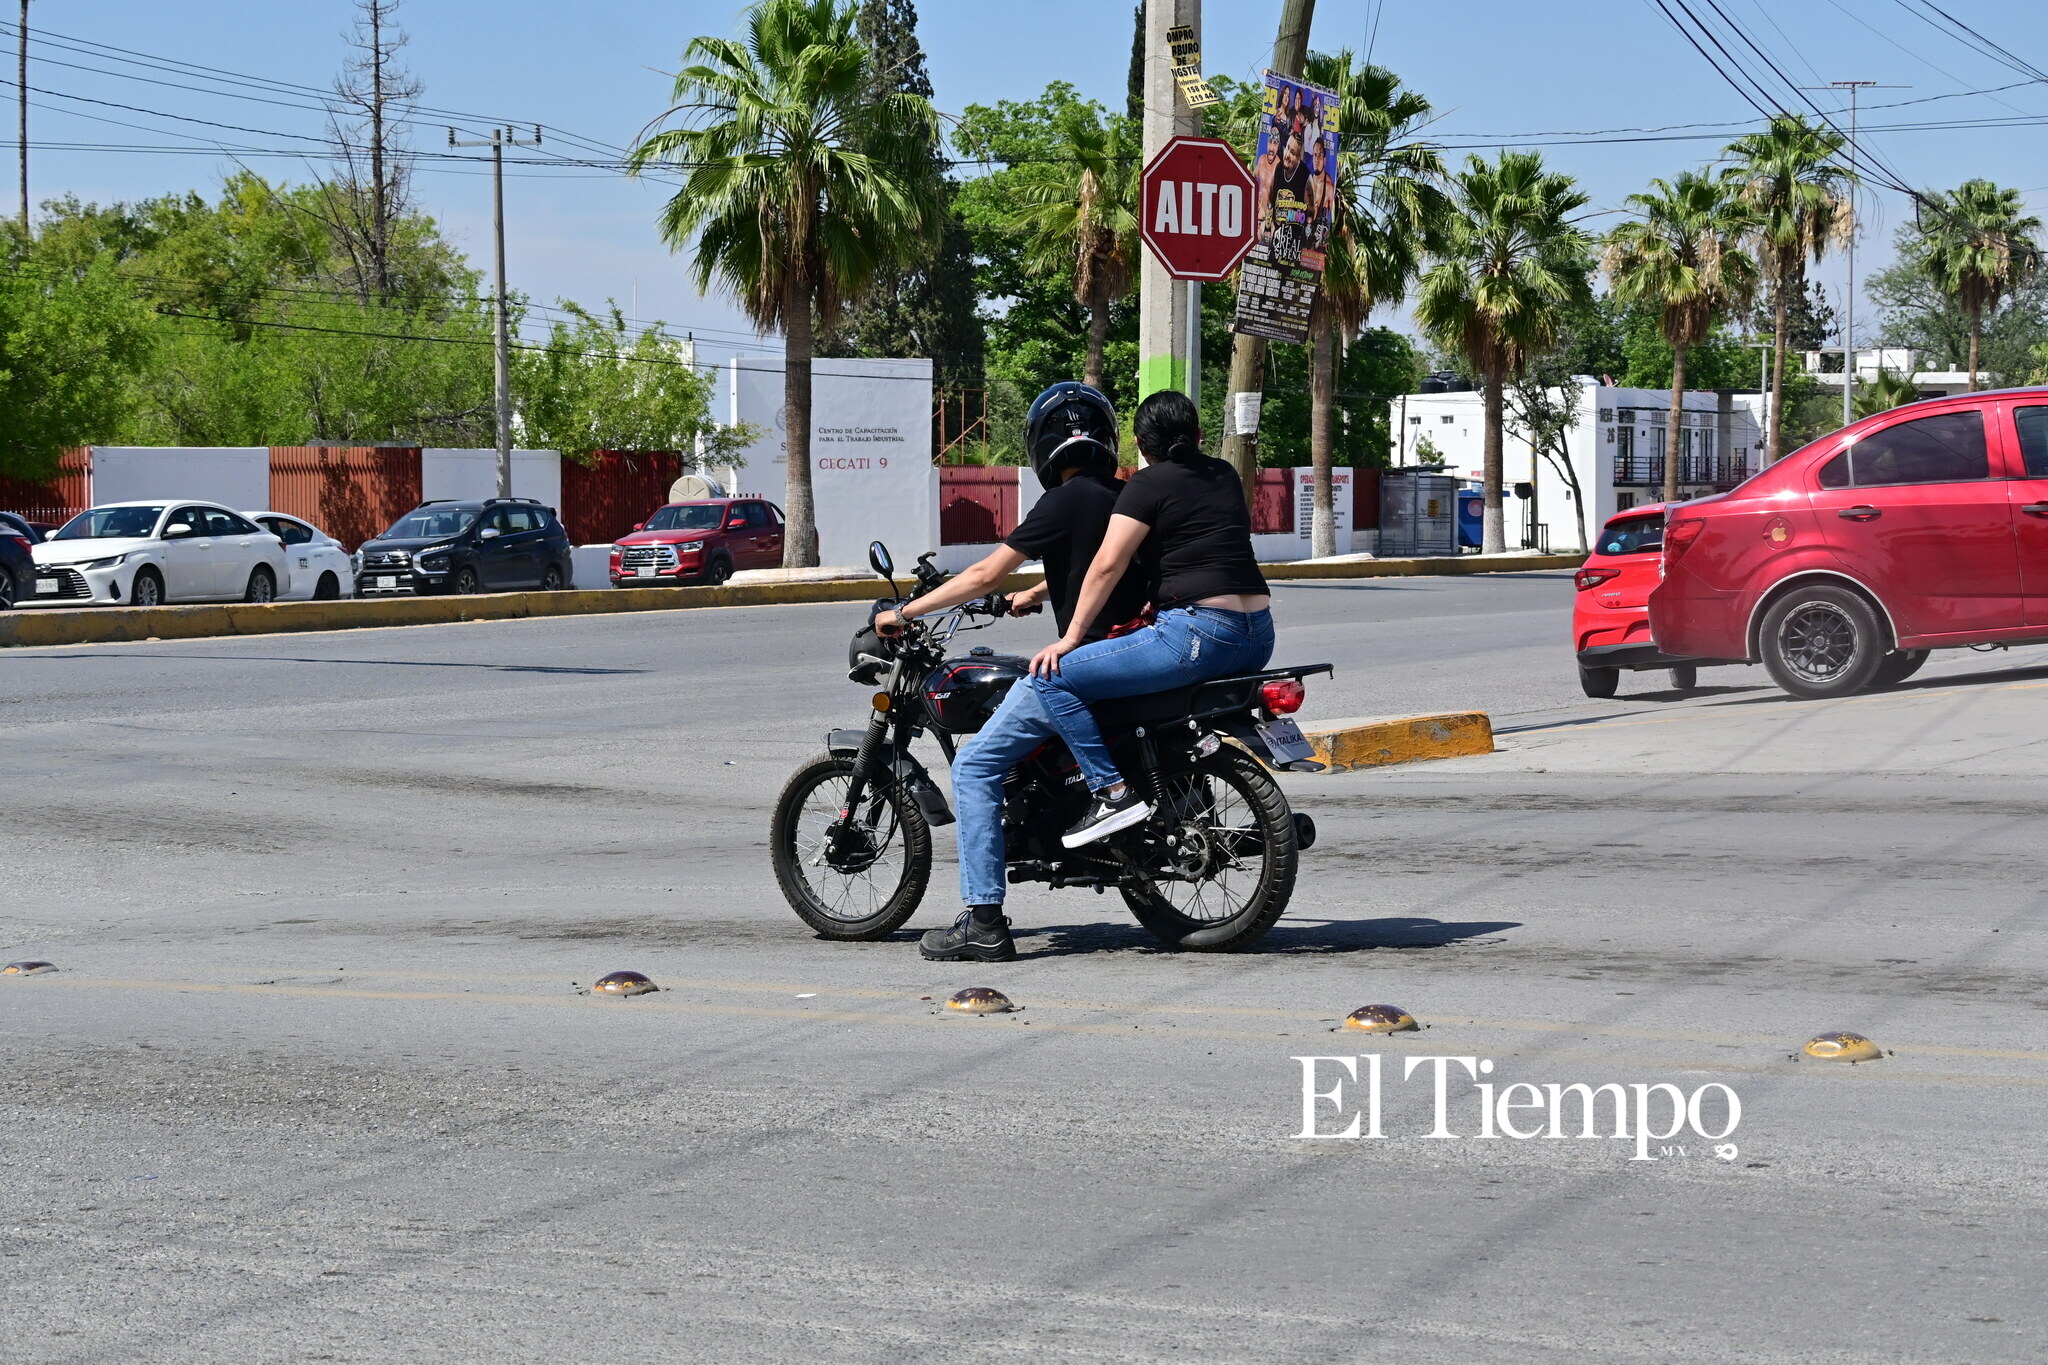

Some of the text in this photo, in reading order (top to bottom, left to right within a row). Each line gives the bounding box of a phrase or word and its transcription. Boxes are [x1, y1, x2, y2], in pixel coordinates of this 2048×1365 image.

[1166, 28, 1194, 43] OMPRO
[1171, 42, 1199, 57] RBURO
[1176, 56, 1187, 66] DE
[1170, 65, 1198, 78] NGSTE
[1323, 105, 1340, 132] 29
[1154, 180, 1243, 238] ALTO
[819, 457, 888, 469] CECATI 9
[1276, 733, 1302, 747] ITALIKA
[1065, 772, 1085, 786] ITALI
